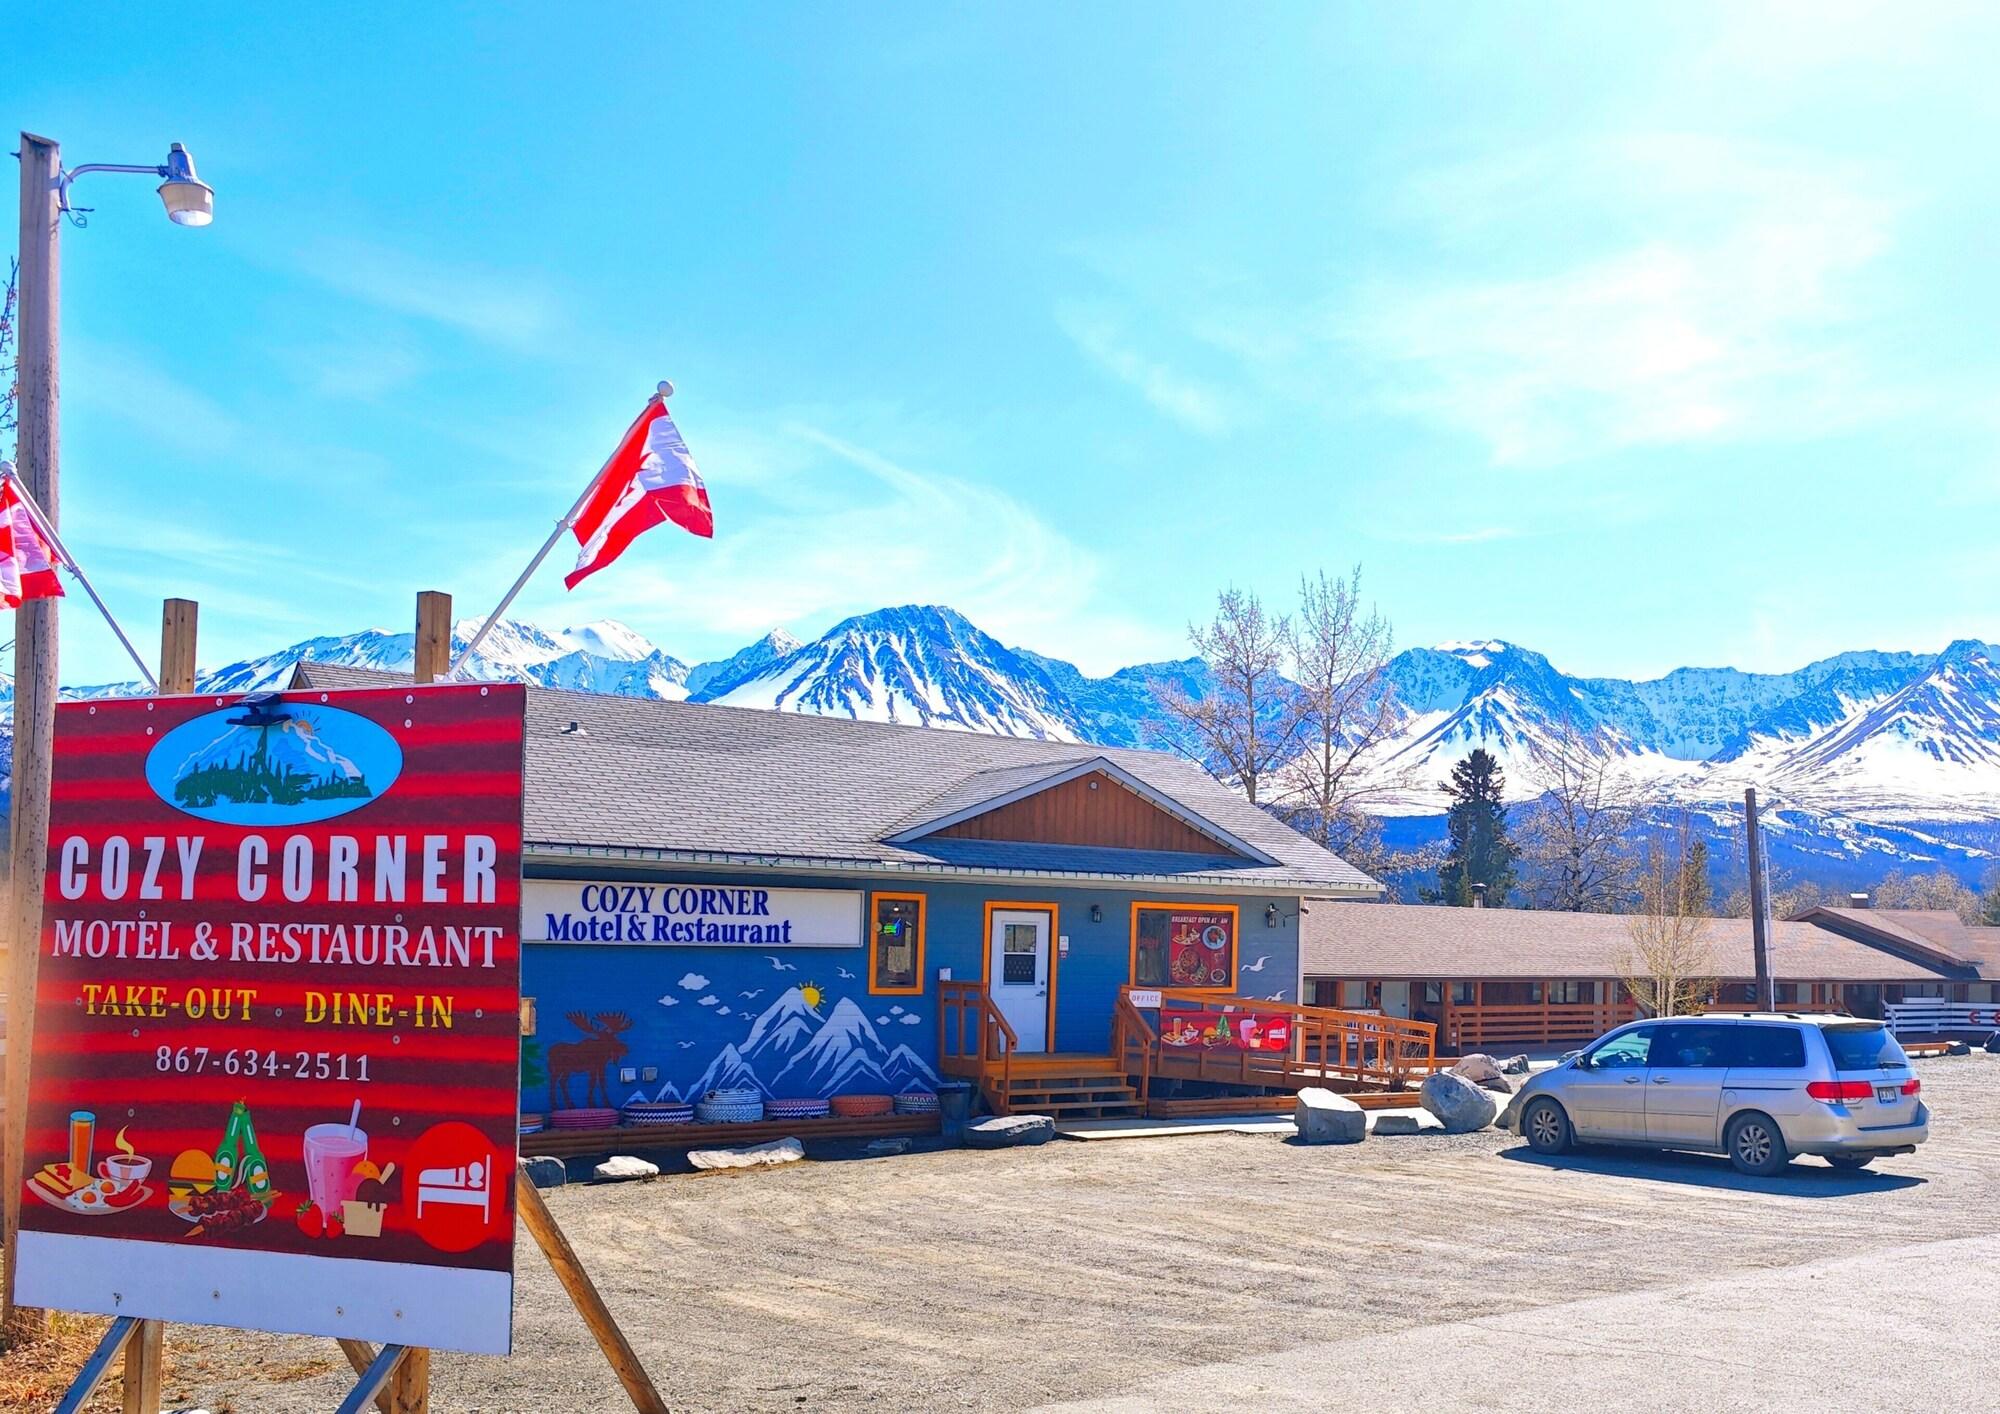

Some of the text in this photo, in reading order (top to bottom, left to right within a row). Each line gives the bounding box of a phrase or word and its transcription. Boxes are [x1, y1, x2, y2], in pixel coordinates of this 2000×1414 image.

[60, 835, 498, 903] COZY CORNER
[581, 885, 770, 916] COZY CORNER
[52, 920, 503, 968] MOTEL & RESTAURANT
[545, 913, 792, 944] Motel & Restaurant
[83, 984, 455, 1028] TAKE-OUT DINE-IN
[155, 1045, 371, 1082] 867-634-2511
